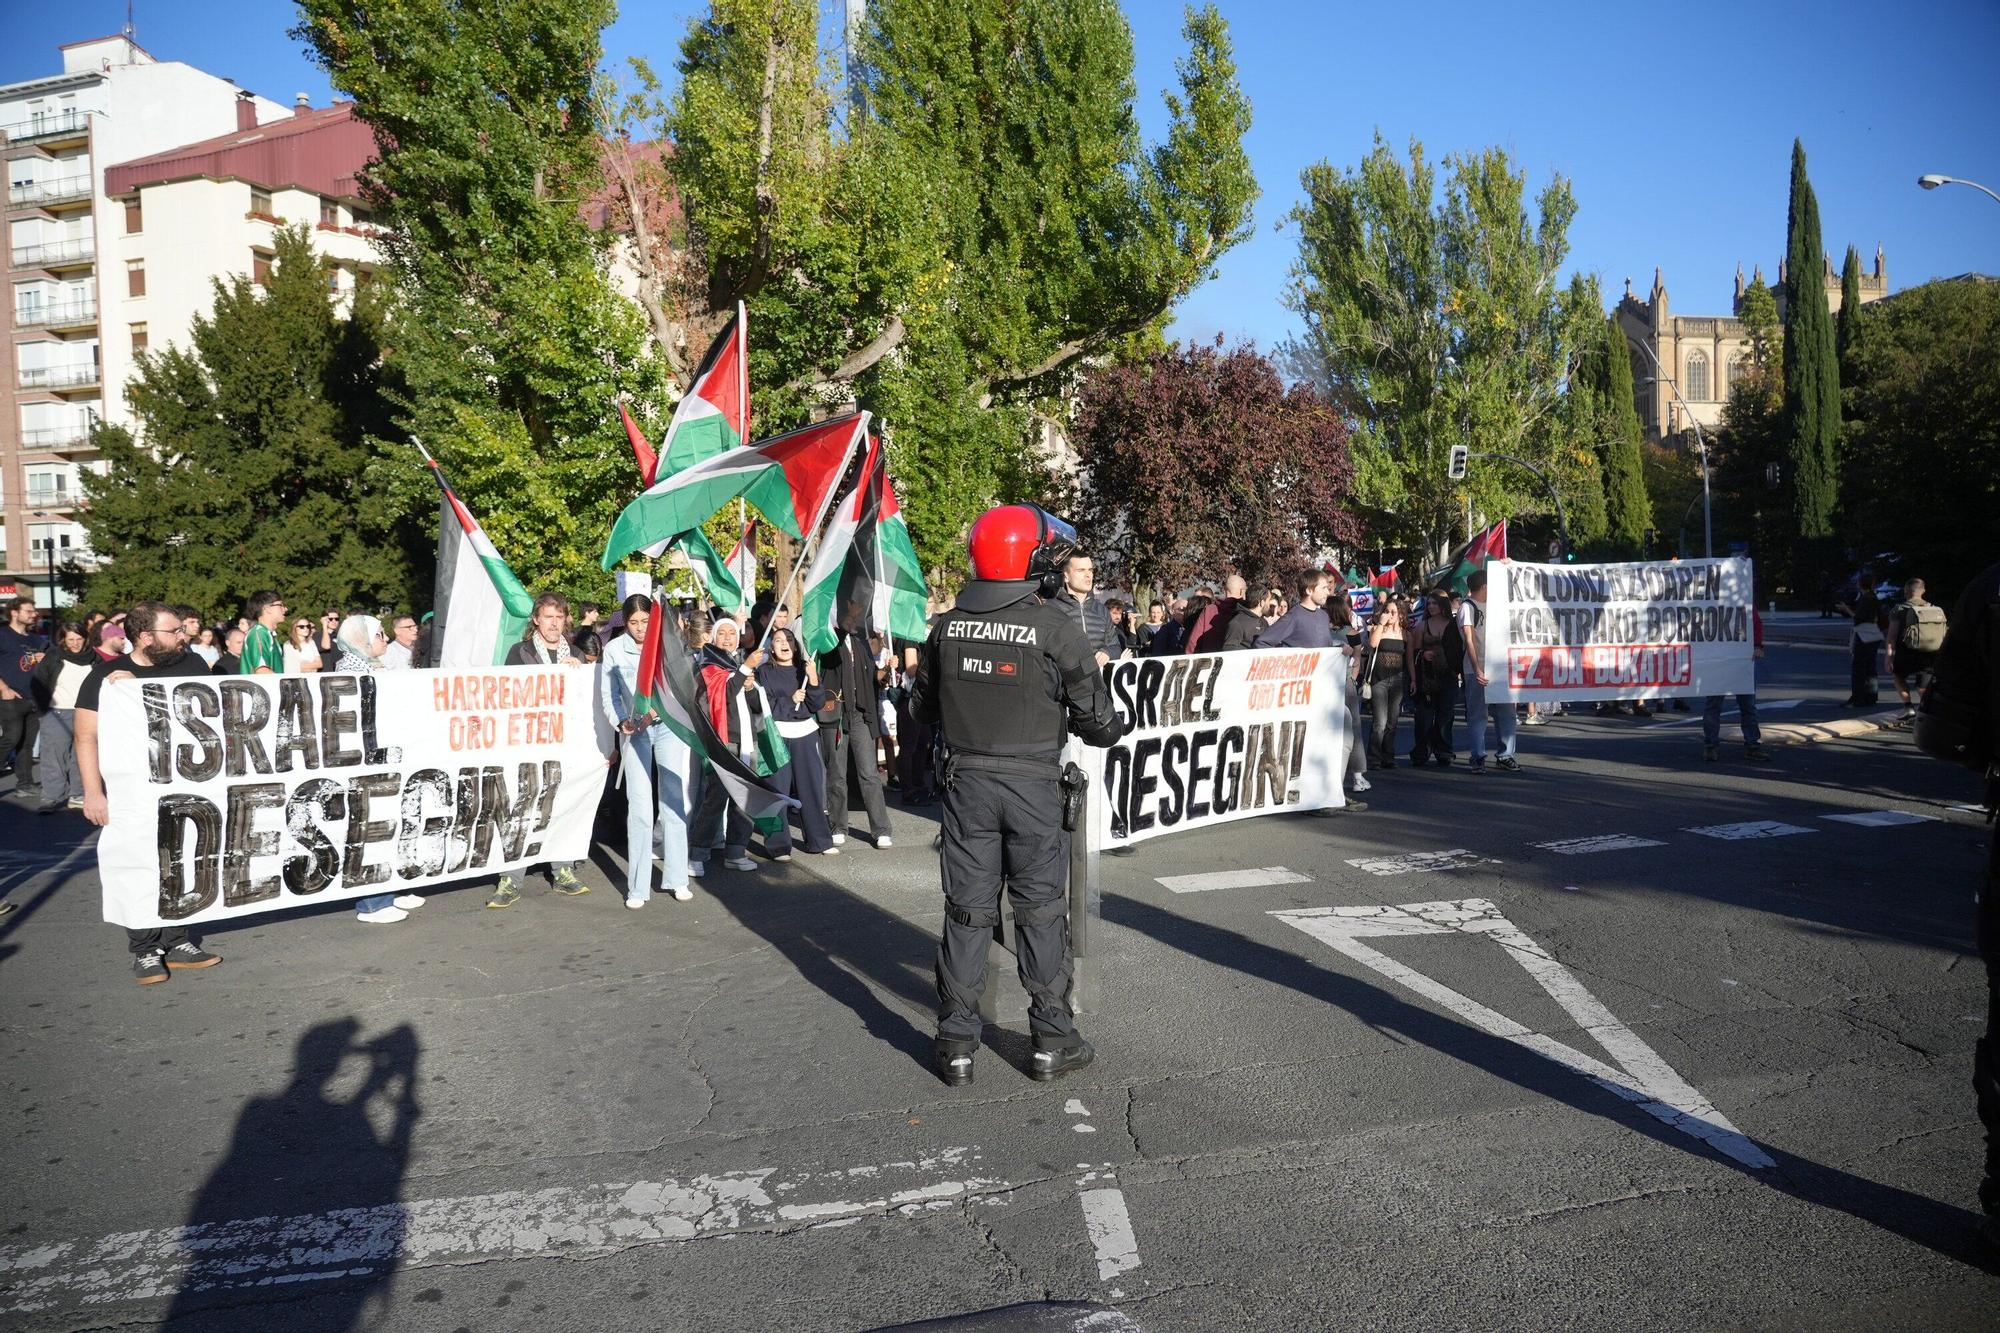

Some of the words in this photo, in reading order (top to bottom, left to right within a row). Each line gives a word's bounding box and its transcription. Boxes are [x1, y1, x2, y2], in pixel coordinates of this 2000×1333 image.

[947, 620, 1037, 645] ERTZAINTZA
[1509, 606, 1640, 645] KONTRAKO
[1647, 606, 1747, 643] BORROKA
[963, 657, 993, 675] M7L9
[1246, 652, 1320, 680] HARREMAN
[1512, 650, 1543, 686] EZ
[1552, 648, 1583, 686] DA
[1593, 645, 1690, 684] BUKATU!
[432, 673, 565, 711] HARREMAN
[1248, 682, 1275, 710] ORO
[1278, 680, 1312, 707] ETEN
[142, 675, 402, 784] ISRAEL
[449, 715, 496, 750] ORO
[507, 711, 564, 746] ETEN
[1104, 720, 1307, 839] DESEGIN!
[157, 760, 562, 920] DESEGIN!
